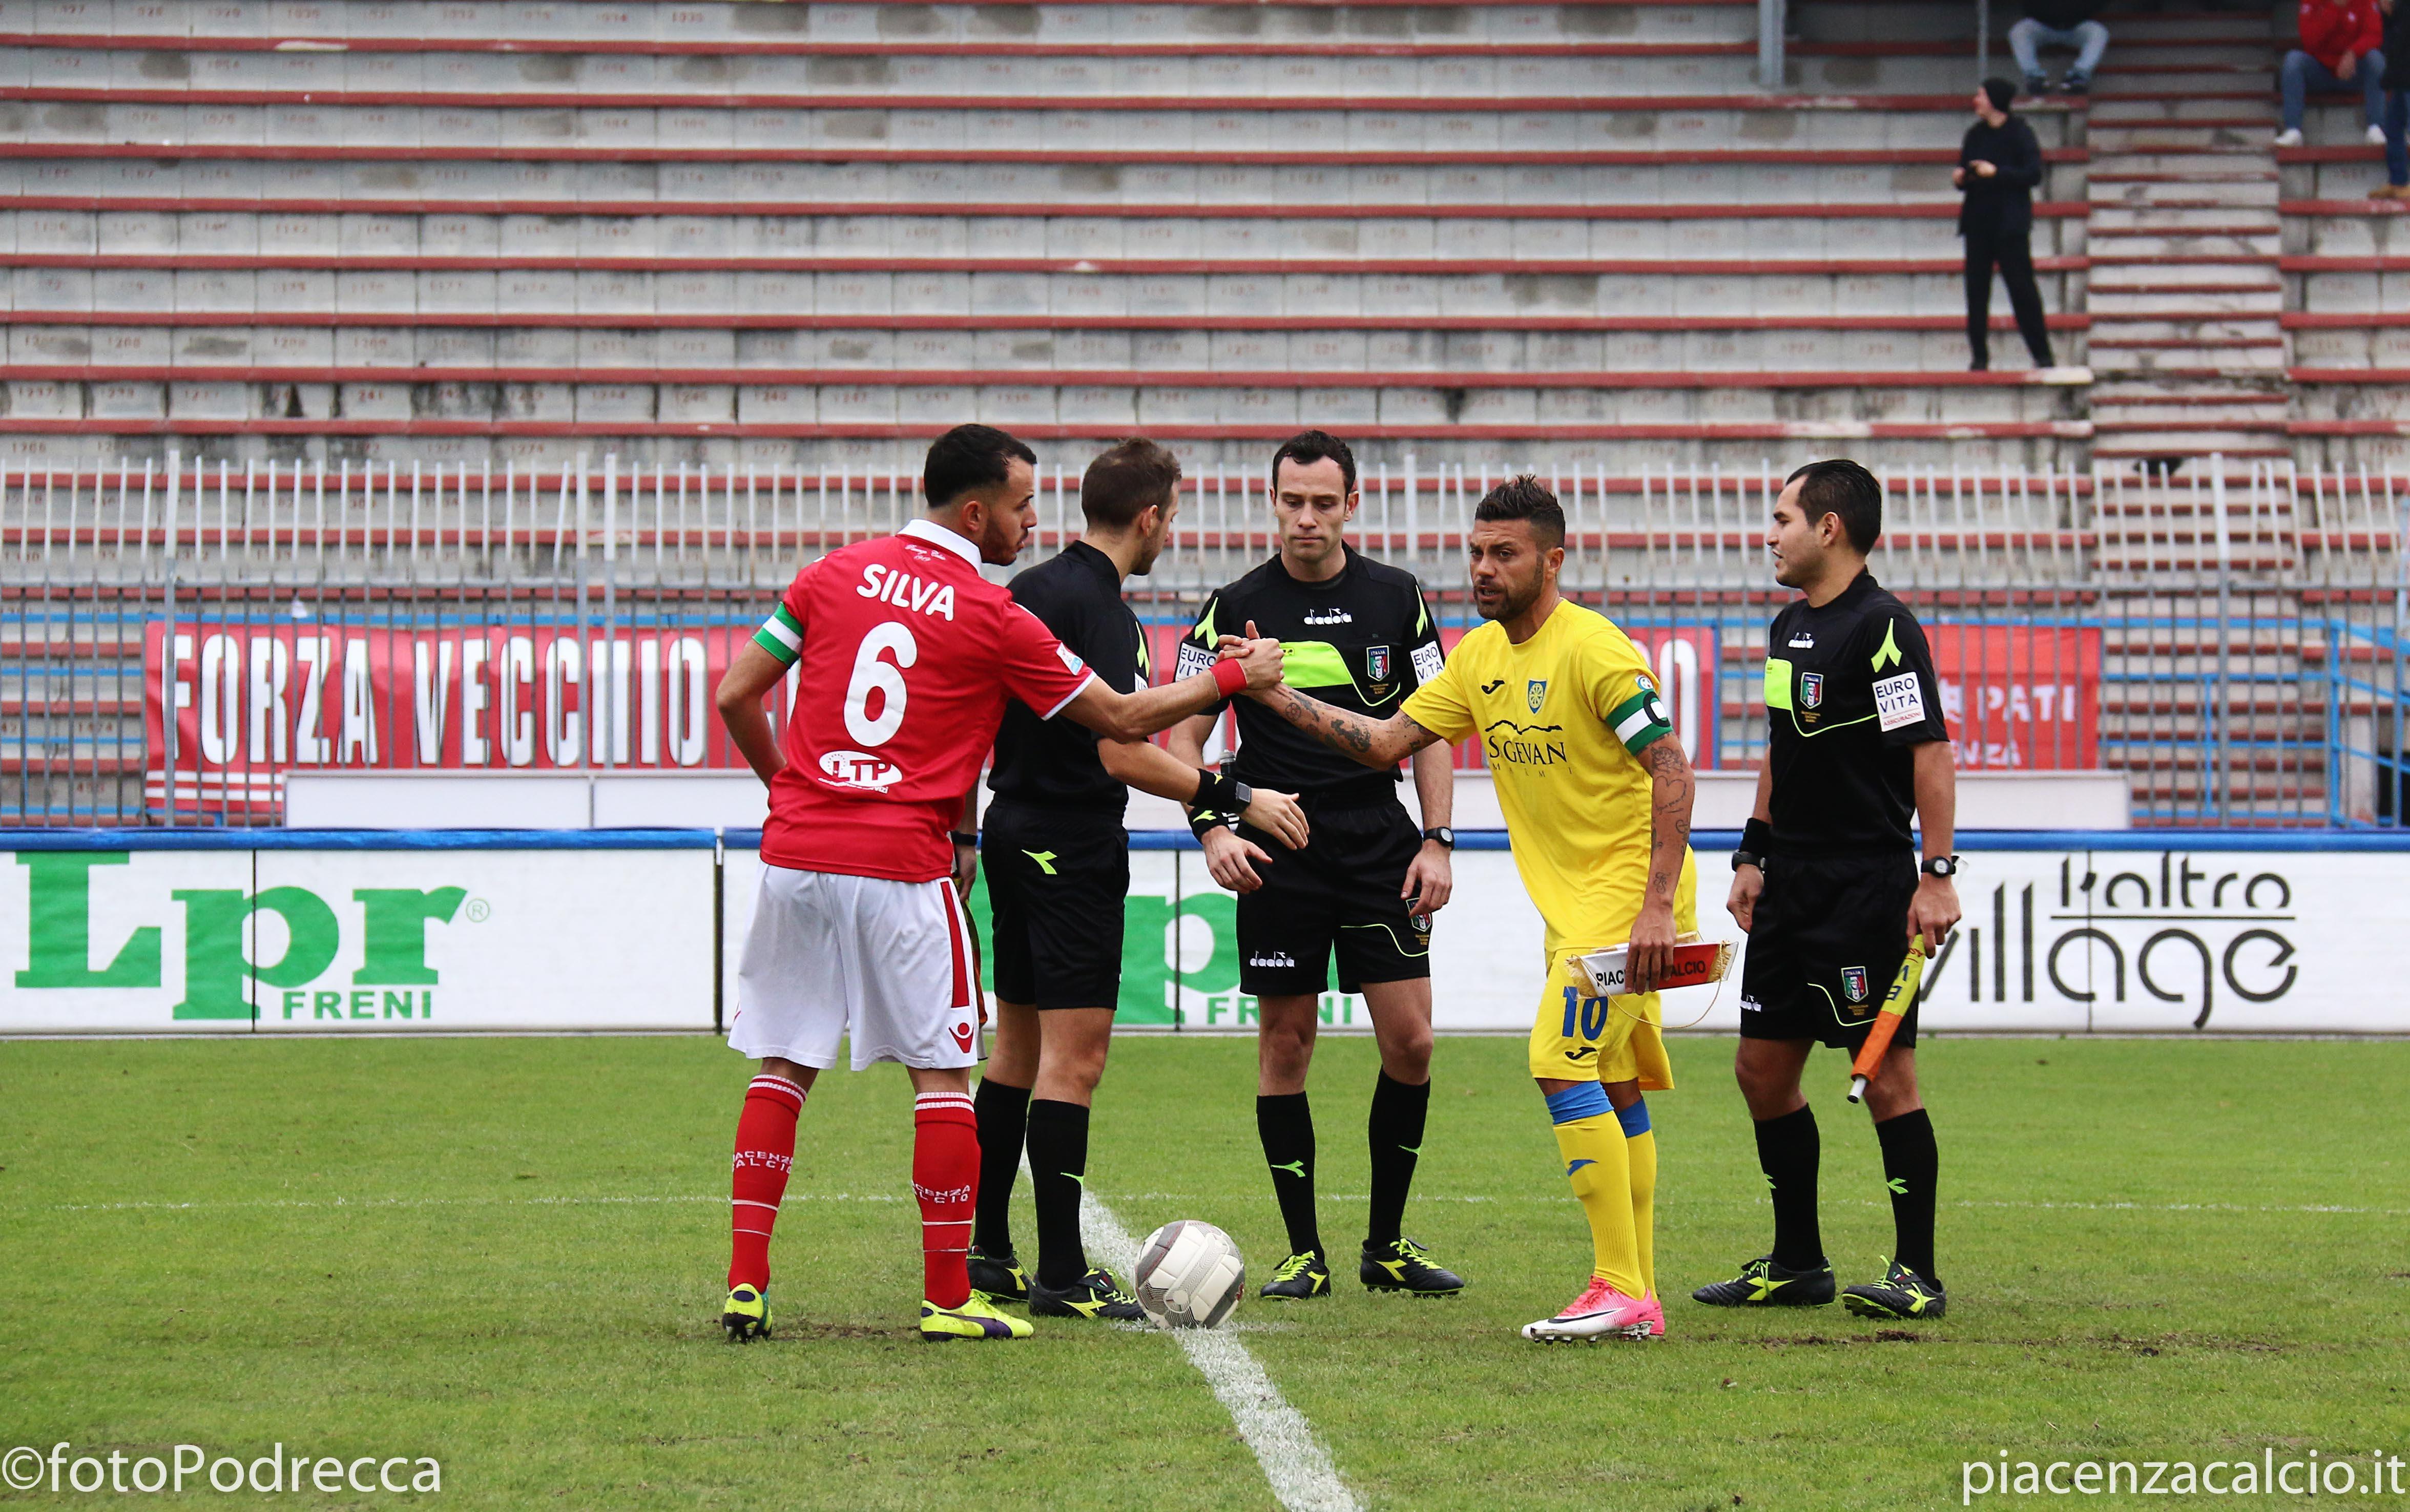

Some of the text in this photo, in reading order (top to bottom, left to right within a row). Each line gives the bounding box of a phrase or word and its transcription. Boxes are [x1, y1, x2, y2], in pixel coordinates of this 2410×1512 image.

[856, 563, 955, 621] SILVA
[1180, 648, 1217, 667] EURO
[1414, 647, 1438, 666] EURO
[1179, 663, 1203, 677] VIT
[1418, 661, 1444, 680] VITA
[843, 621, 918, 747] 6
[1876, 678, 1915, 698] EURO
[161, 634, 707, 767] FORZA VECCHIO
[1880, 693, 1919, 713] VITA
[832, 760, 891, 782] LTP
[1596, 960, 1706, 987] PIAC ALCIO
[282, 991, 432, 1019] FRENI
[1207, 997, 1352, 1024] FRNI
[1562, 986, 1608, 1040] 10
